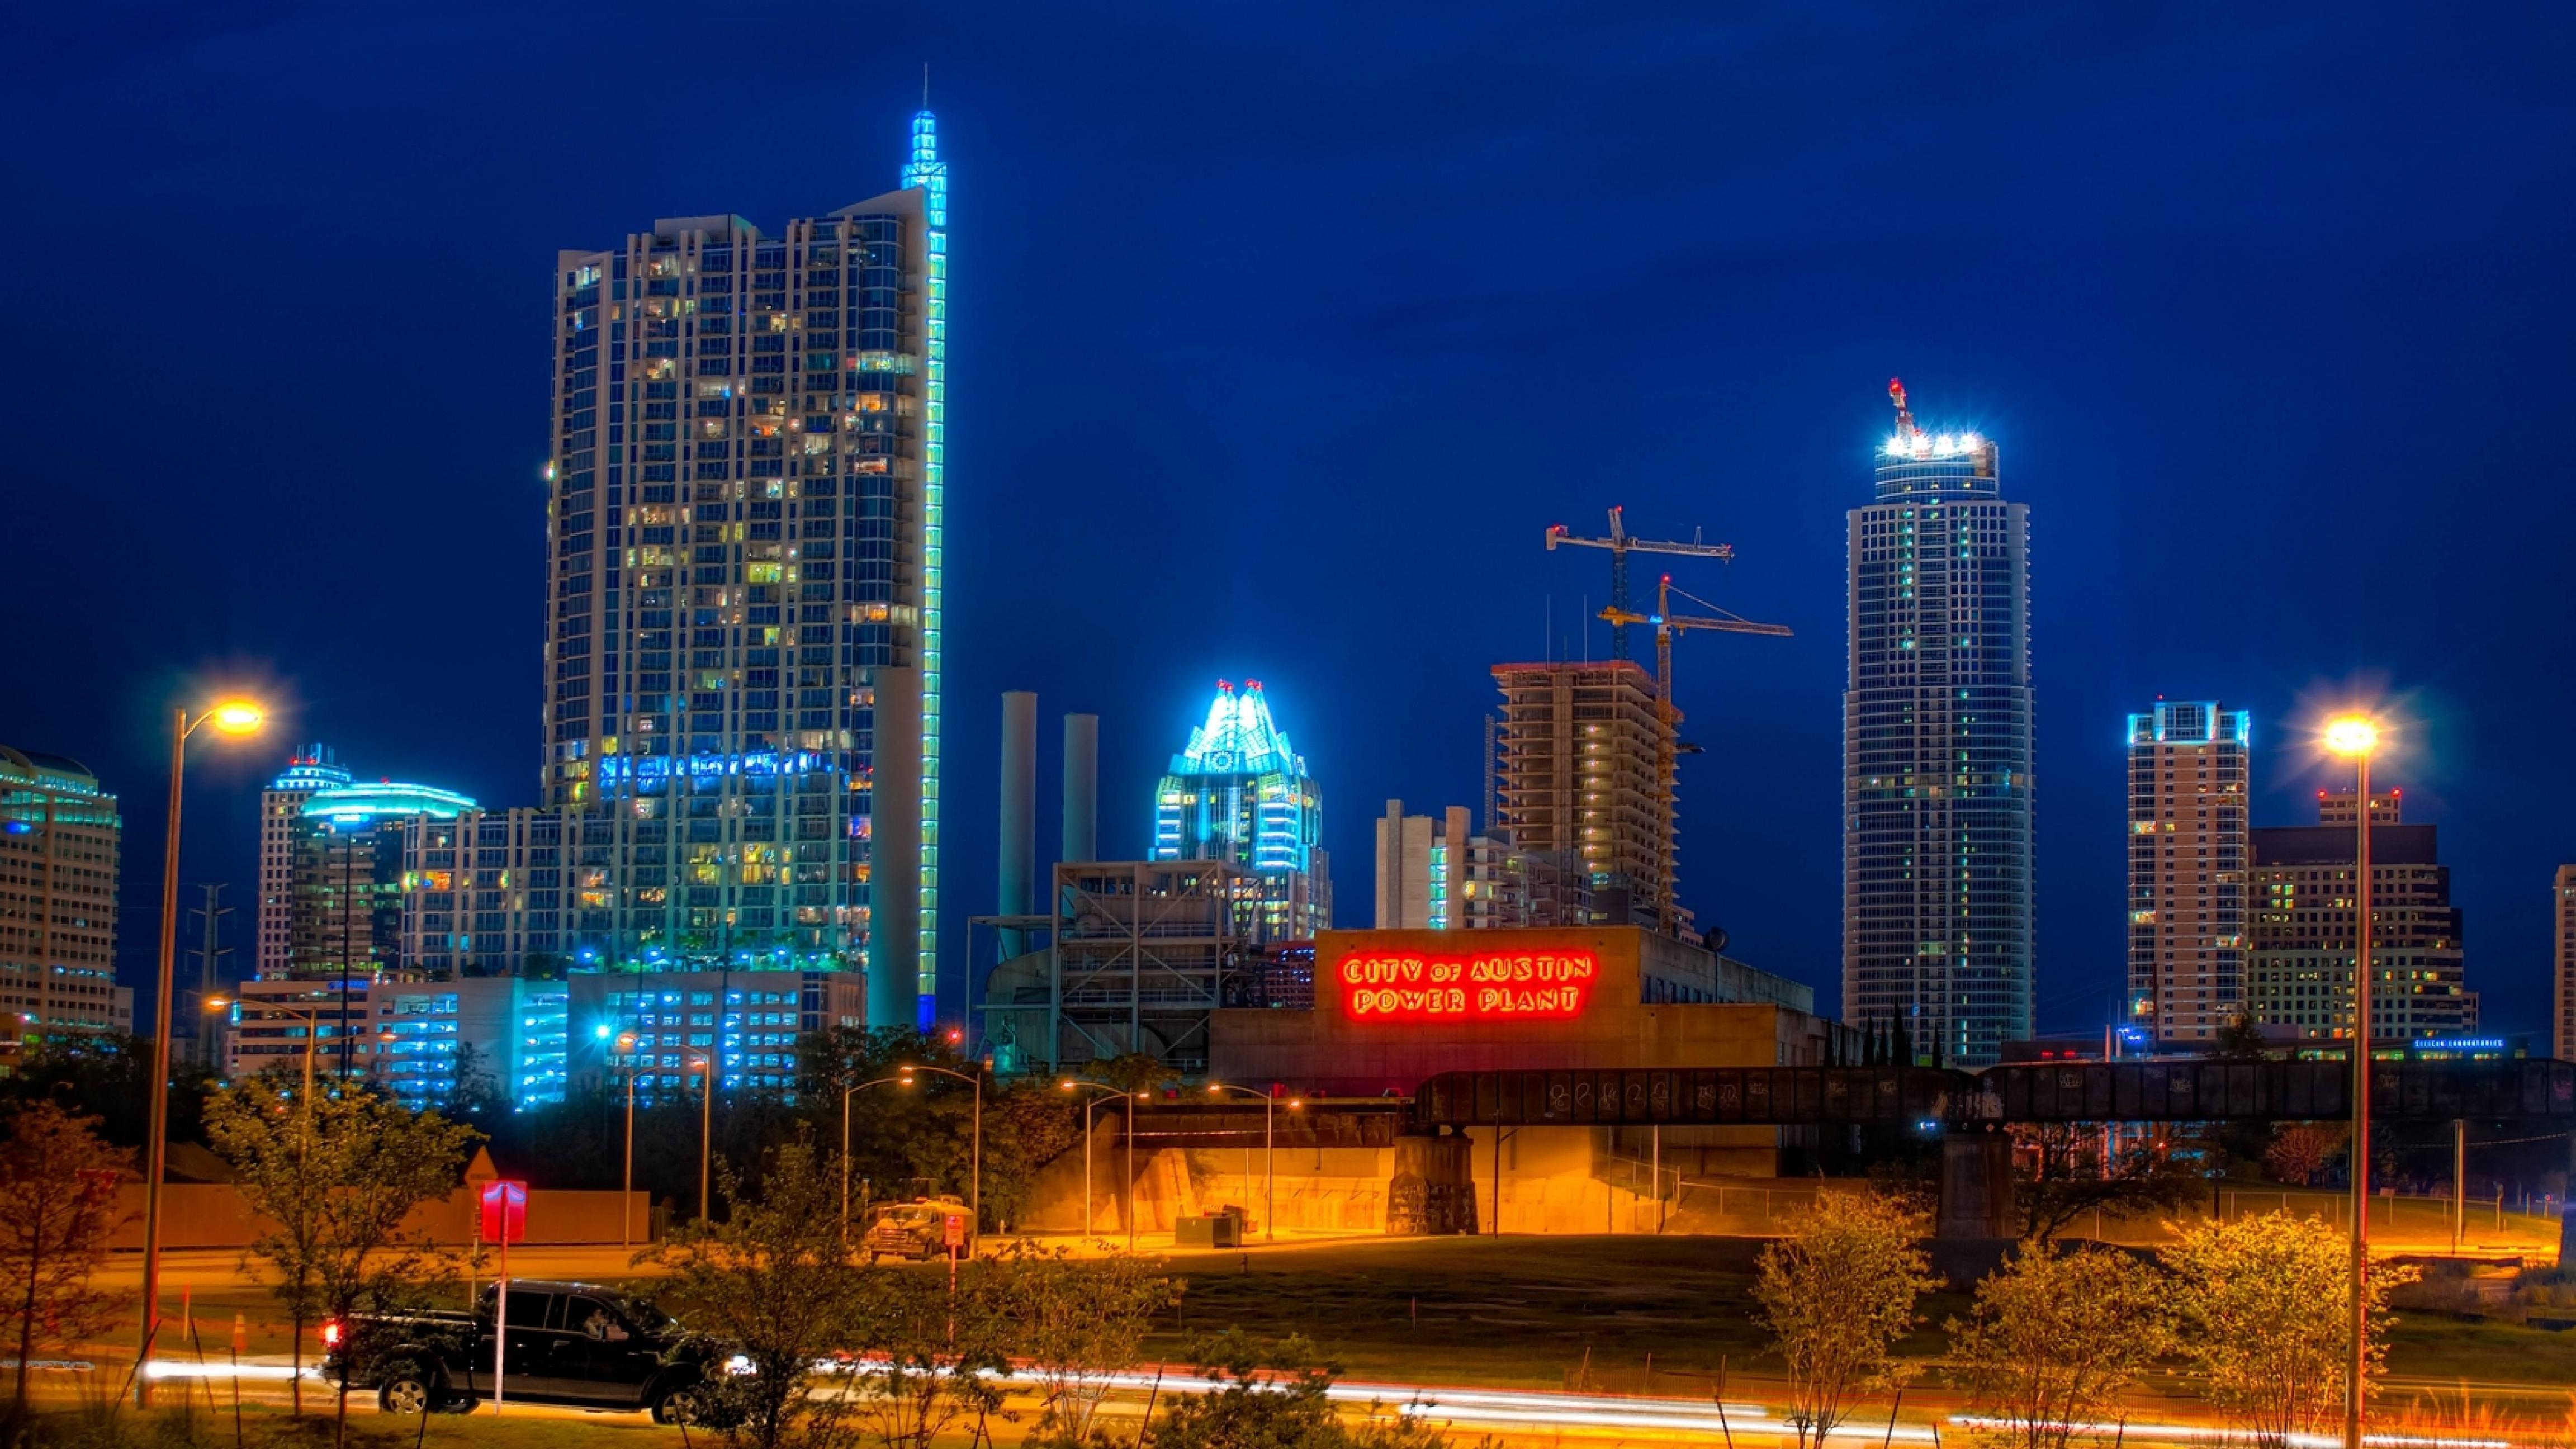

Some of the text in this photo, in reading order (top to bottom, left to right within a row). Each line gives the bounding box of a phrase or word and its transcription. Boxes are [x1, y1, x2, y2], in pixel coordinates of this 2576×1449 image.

[1344, 959, 1422, 983] CITY
[1470, 956, 1592, 982] AUSTIN
[1354, 987, 1579, 1014] POWER PLANT
